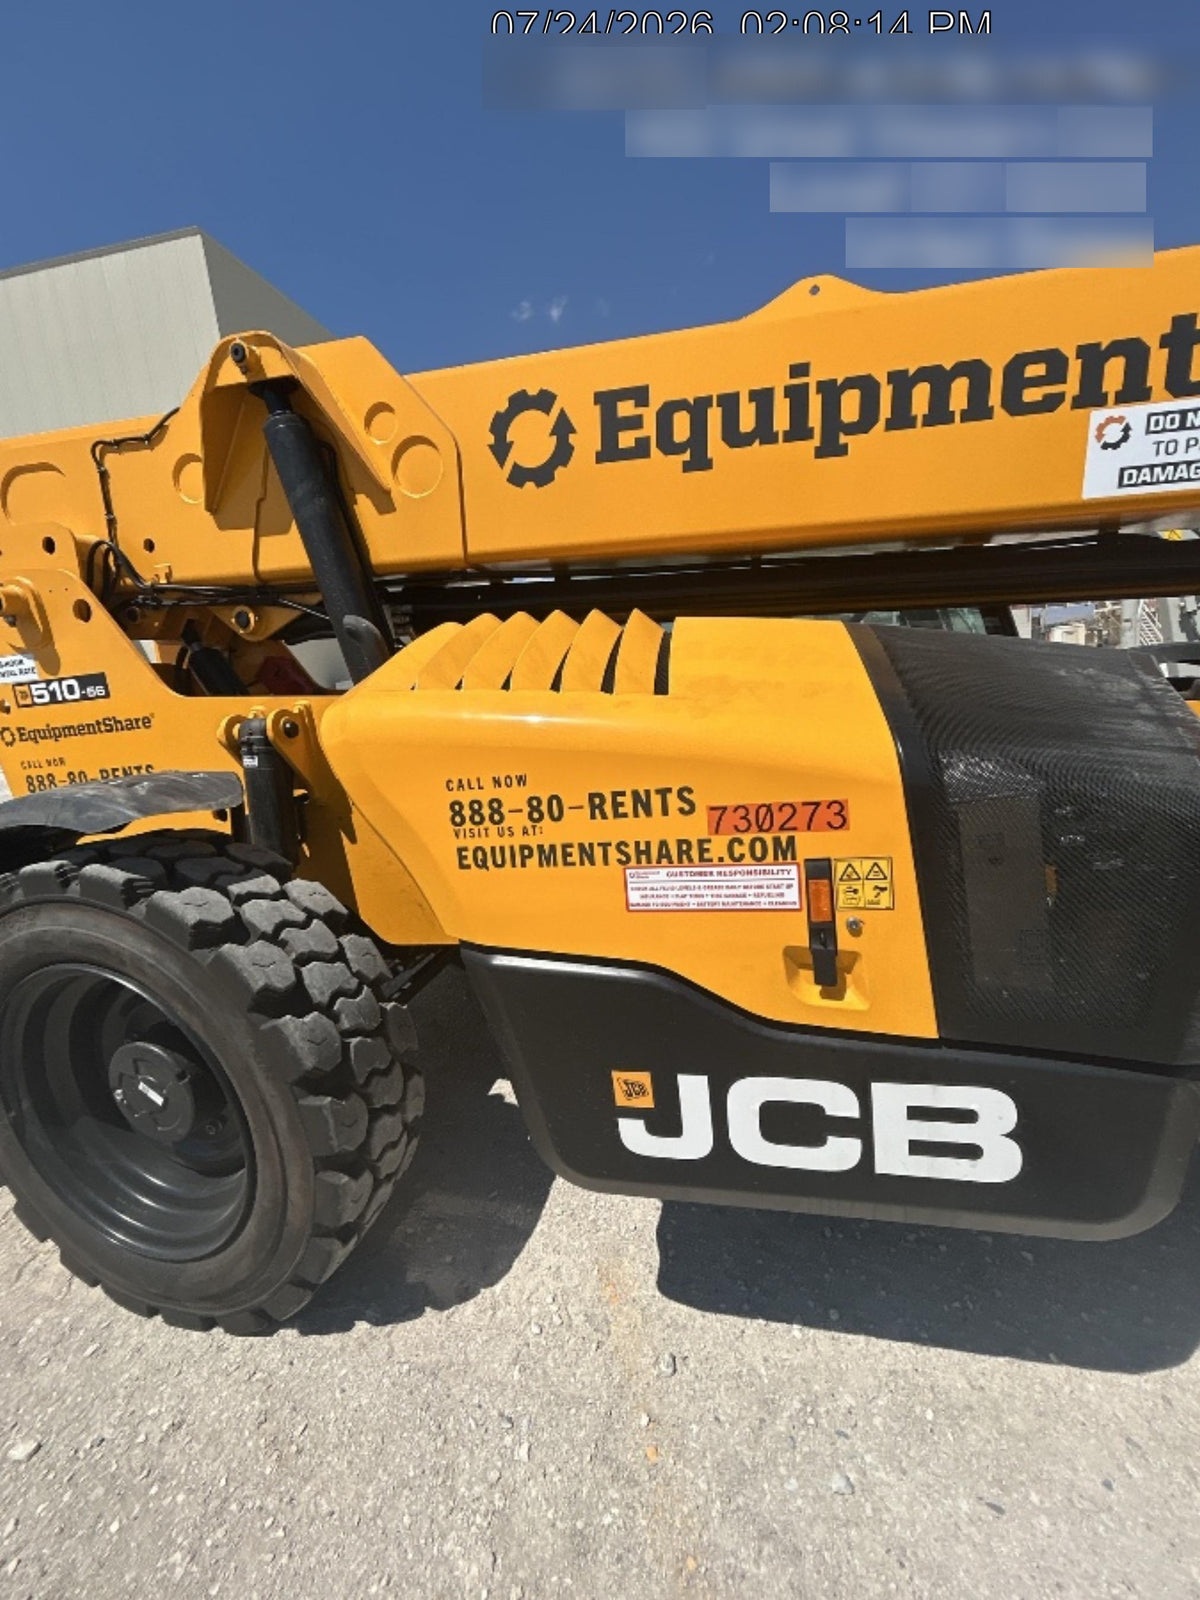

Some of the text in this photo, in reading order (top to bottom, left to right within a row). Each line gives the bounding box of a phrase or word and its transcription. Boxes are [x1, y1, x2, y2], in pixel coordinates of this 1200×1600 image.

[594, 312, 1200, 474] Equipment
[1148, 412, 1180, 432] DO
[1152, 439, 1178, 457] TO
[445, 773, 527, 792] CALL NOW
[449, 786, 696, 828] 888-80-RENTS
[709, 800, 848, 835] 730273
[453, 824, 543, 840] VISIT US AT:
[456, 835, 797, 872] EQUIPMENTSHARE.COM
[618, 1074, 1023, 1183] JCB
